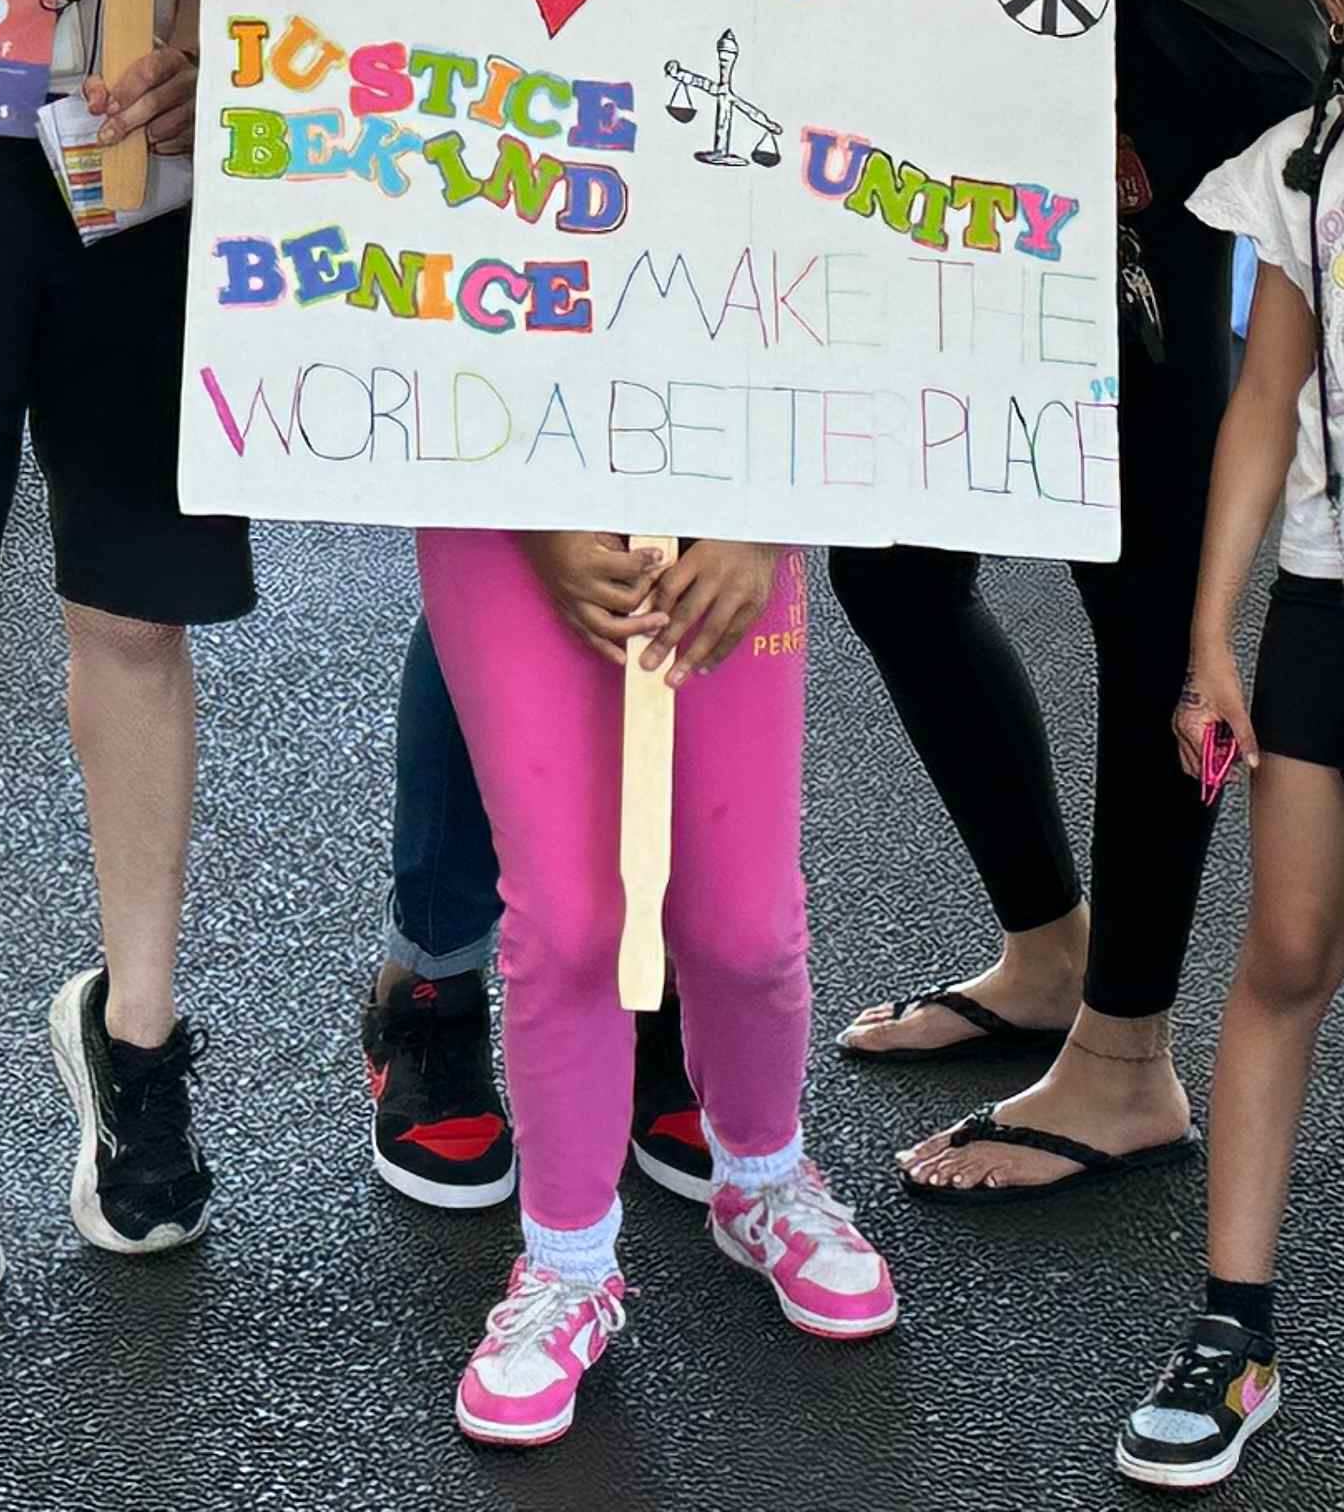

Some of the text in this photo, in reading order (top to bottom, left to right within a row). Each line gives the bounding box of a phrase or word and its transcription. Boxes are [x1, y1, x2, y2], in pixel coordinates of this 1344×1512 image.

[226, 15, 637, 152] JUSTICE
[800, 126, 1081, 261] UNITY
[607, 247, 883, 349] MAKE
[908, 257, 1098, 366] THE
[200, 361, 512, 463] WORLD
[525, 382, 586, 469] A
[608, 380, 914, 487] BETTER
